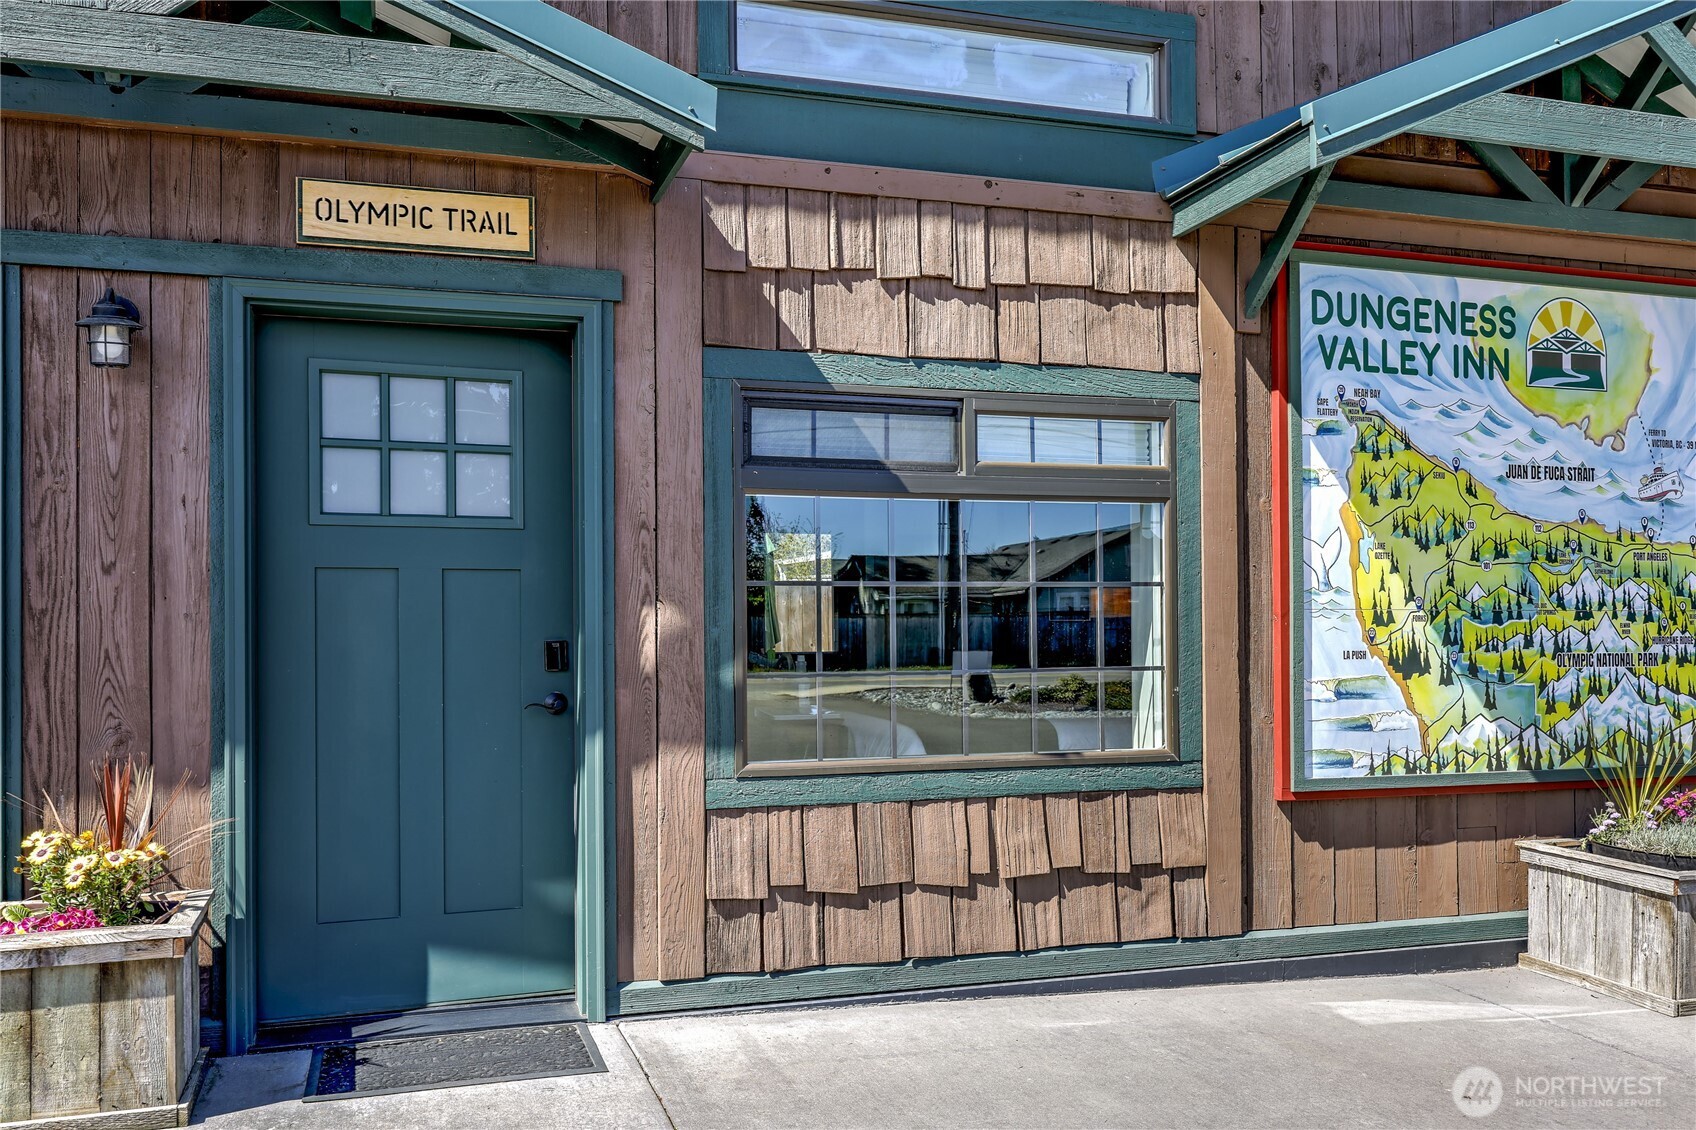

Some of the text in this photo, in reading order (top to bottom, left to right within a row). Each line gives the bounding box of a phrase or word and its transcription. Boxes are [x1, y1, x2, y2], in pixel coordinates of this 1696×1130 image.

[315, 197, 518, 236] OLYMPIC TRAIL
[1311, 289, 1517, 340] DUNGENESS
[1318, 334, 1510, 382] VALLEY INN
[1354, 388, 1381, 399] NEAH BAY
[1317, 398, 1329, 406] CAPE
[1317, 408, 1338, 416] FLATTERY
[1652, 439, 1674, 449] VICTORIA,
[1675, 440, 1683, 448] BC
[1686, 441, 1694, 449] 39
[1505, 464, 1596, 482] JUAN DE FUCA STRAIT
[1374, 542, 1386, 550] LAKE
[1374, 551, 1390, 559] OZETTE
[1633, 552, 1668, 561] PORT ANGELES
[1413, 614, 1427, 622] FORKS
[1652, 636, 1694, 645] HURRICANE RIDGE
[1343, 650, 1367, 660] LA PUSH
[1556, 652, 1659, 667] OLYMPIC NATIONAL PARK
